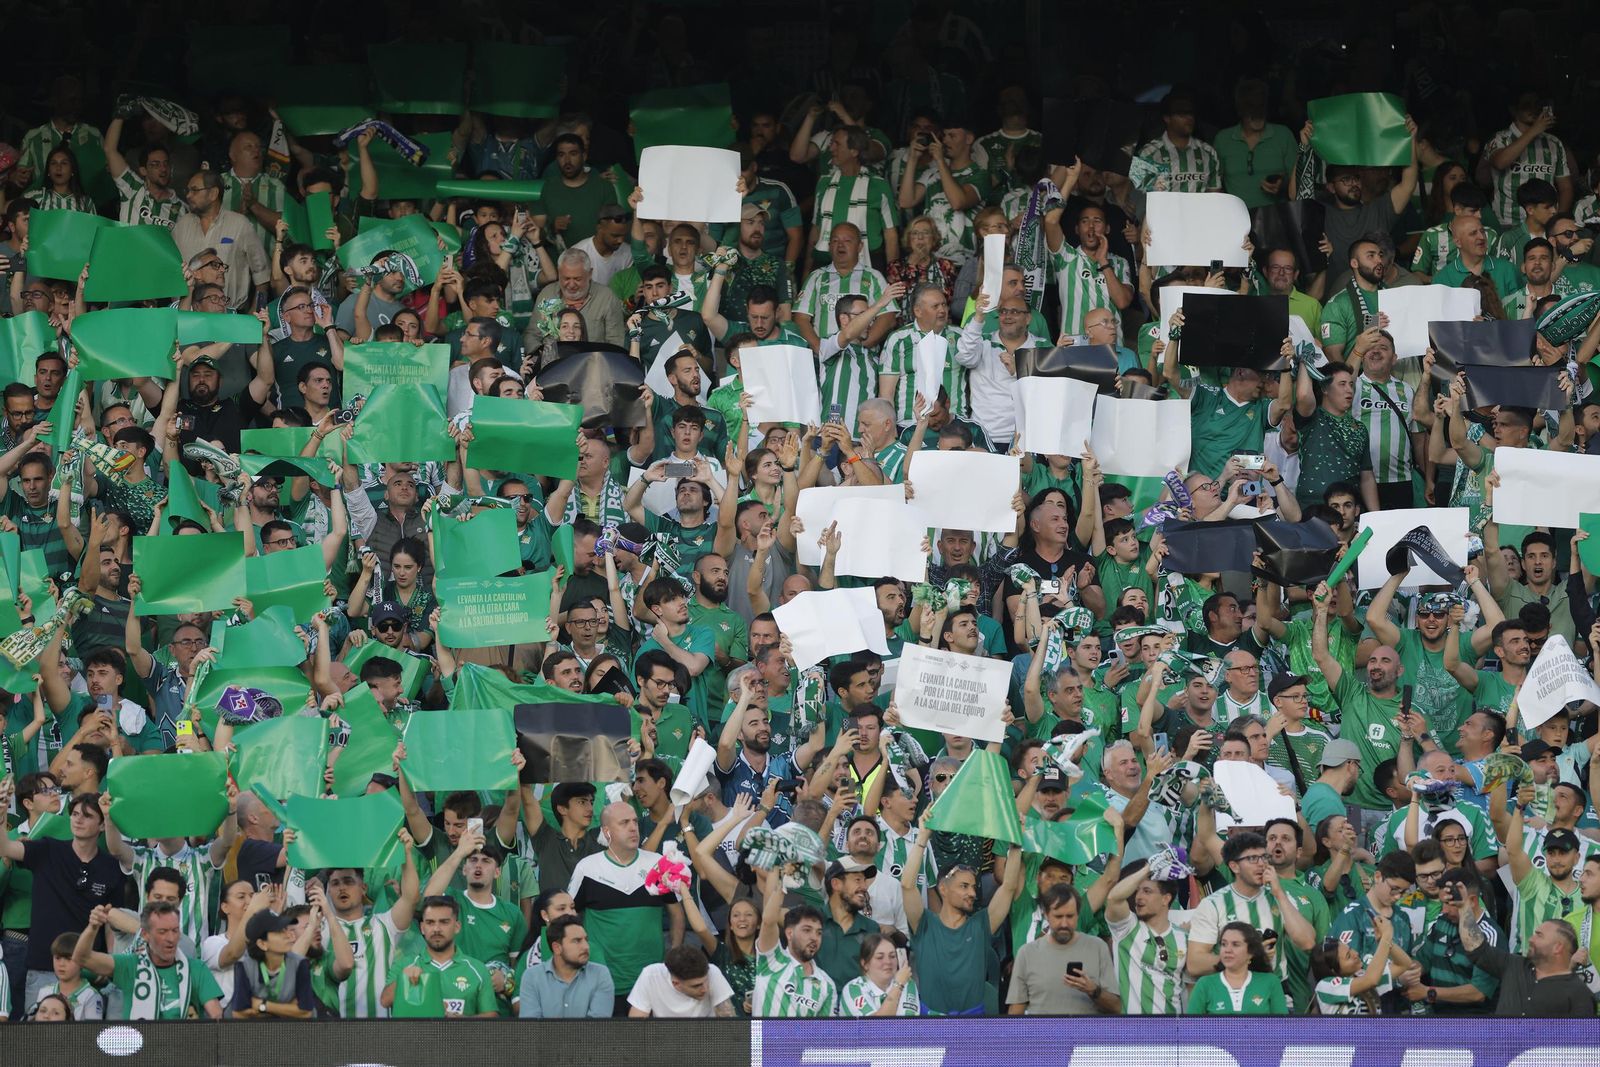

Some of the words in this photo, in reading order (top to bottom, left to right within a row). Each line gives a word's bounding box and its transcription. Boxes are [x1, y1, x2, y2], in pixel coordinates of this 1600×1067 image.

[1174, 173, 1206, 182] GREE
[1523, 164, 1553, 174] GREE
[458, 594, 484, 604] LEVANTA
[493, 593, 526, 601] CARTULINA
[465, 605, 477, 615] POR
[478, 604, 486, 614] LA
[487, 603, 502, 613] OTRA
[503, 602, 520, 611] CARA
[464, 617, 472, 628] LA
[473, 615, 494, 626] SALIDA
[495, 614, 506, 624] DEL
[507, 612, 529, 624] EQUIPO
[1532, 660, 1551, 679] LEVANTA
[1552, 656, 1560, 666] LA
[1538, 674, 1548, 686] POR
[1548, 670, 1555, 679] LA
[1555, 664, 1569, 676] OTRA
[920, 672, 945, 687] LEVANTA
[946, 676, 954, 687] LA
[954, 677, 987, 694] CARTULINA
[1541, 688, 1548, 698] LA
[1548, 675, 1564, 693] SALIDA
[1564, 673, 1573, 683] DEL
[924, 686, 936, 697] POR
[937, 688, 945, 699] LA
[946, 690, 961, 701] OTRA
[962, 692, 978, 704] CARA
[920, 698, 928, 708] LA
[928, 699, 950, 712] SALIDA
[950, 702, 961, 714] DEL
[962, 704, 985, 718] EQUIPO
